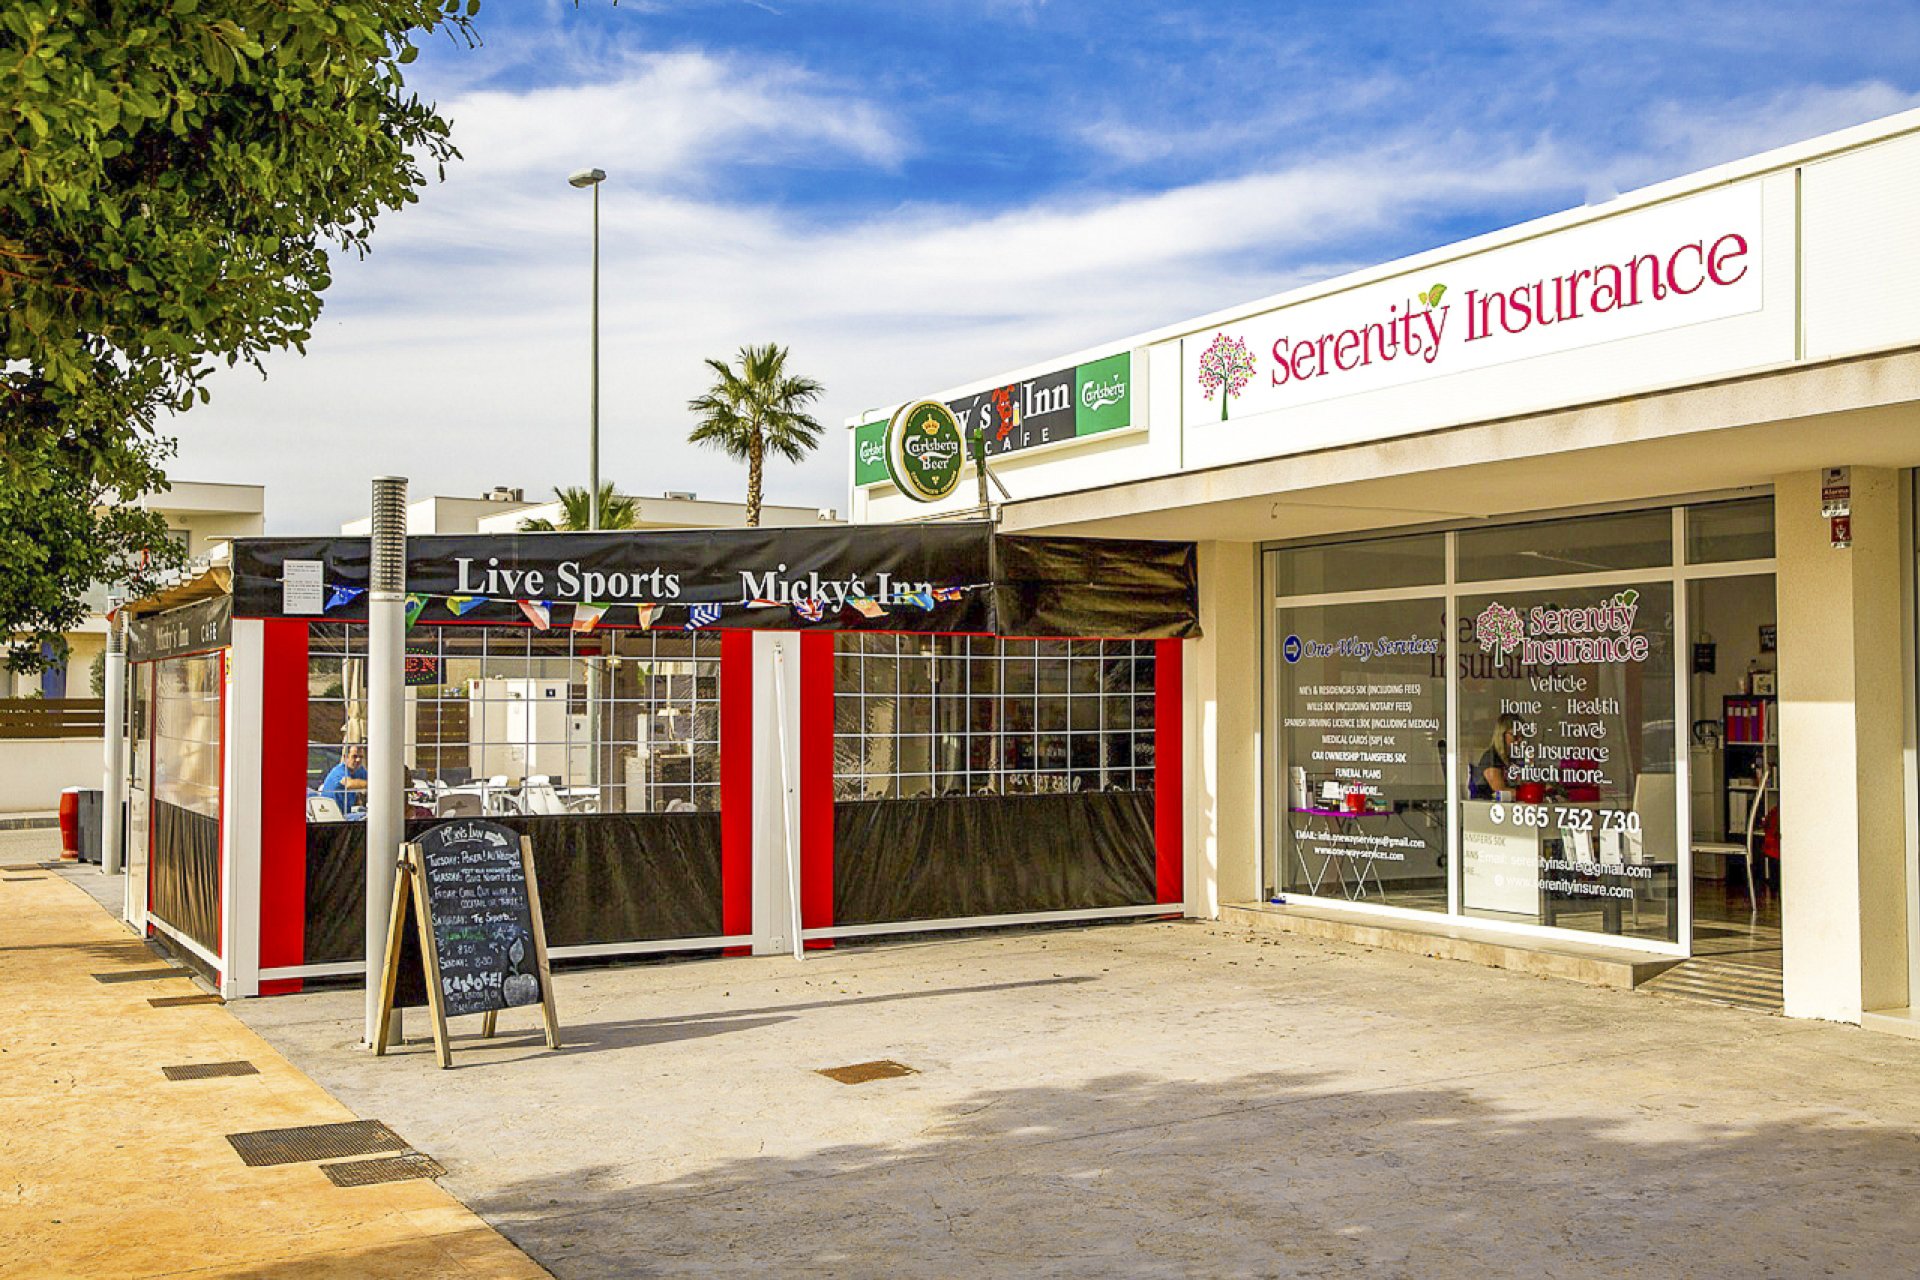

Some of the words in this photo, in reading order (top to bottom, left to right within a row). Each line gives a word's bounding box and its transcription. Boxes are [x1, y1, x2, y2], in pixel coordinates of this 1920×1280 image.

[1271, 298, 1451, 388] Serenity
[1464, 233, 1749, 343] Insurance
[1023, 381, 1071, 419] Inn
[1081, 377, 1127, 411] Carlsberg
[905, 434, 959, 457] Carlsberg
[922, 458, 948, 470] Beer
[454, 557, 544, 595] Live
[556, 560, 681, 603] Sports
[738, 563, 866, 613] Micky's
[876, 572, 934, 605] Inn
[1530, 597, 1638, 635] Serenity
[1375, 634, 1439, 657] Services
[1522, 635, 1649, 665] Insurance
[1530, 674, 1587, 693] Vehicle
[1501, 698, 1542, 714] Home
[1567, 697, 1619, 715] Health
[1512, 720, 1538, 738] Pet
[1559, 720, 1607, 739] Travel
[1510, 741, 1535, 759] Life
[1538, 743, 1609, 762] Insurance
[1512, 805, 1549, 827] 865
[1555, 807, 1593, 830] 752
[1600, 809, 1640, 833] 730
[1510, 853, 1652, 879] serenityinsure@gmail.com
[1505, 875, 1634, 899] www.serenityinsure.com
